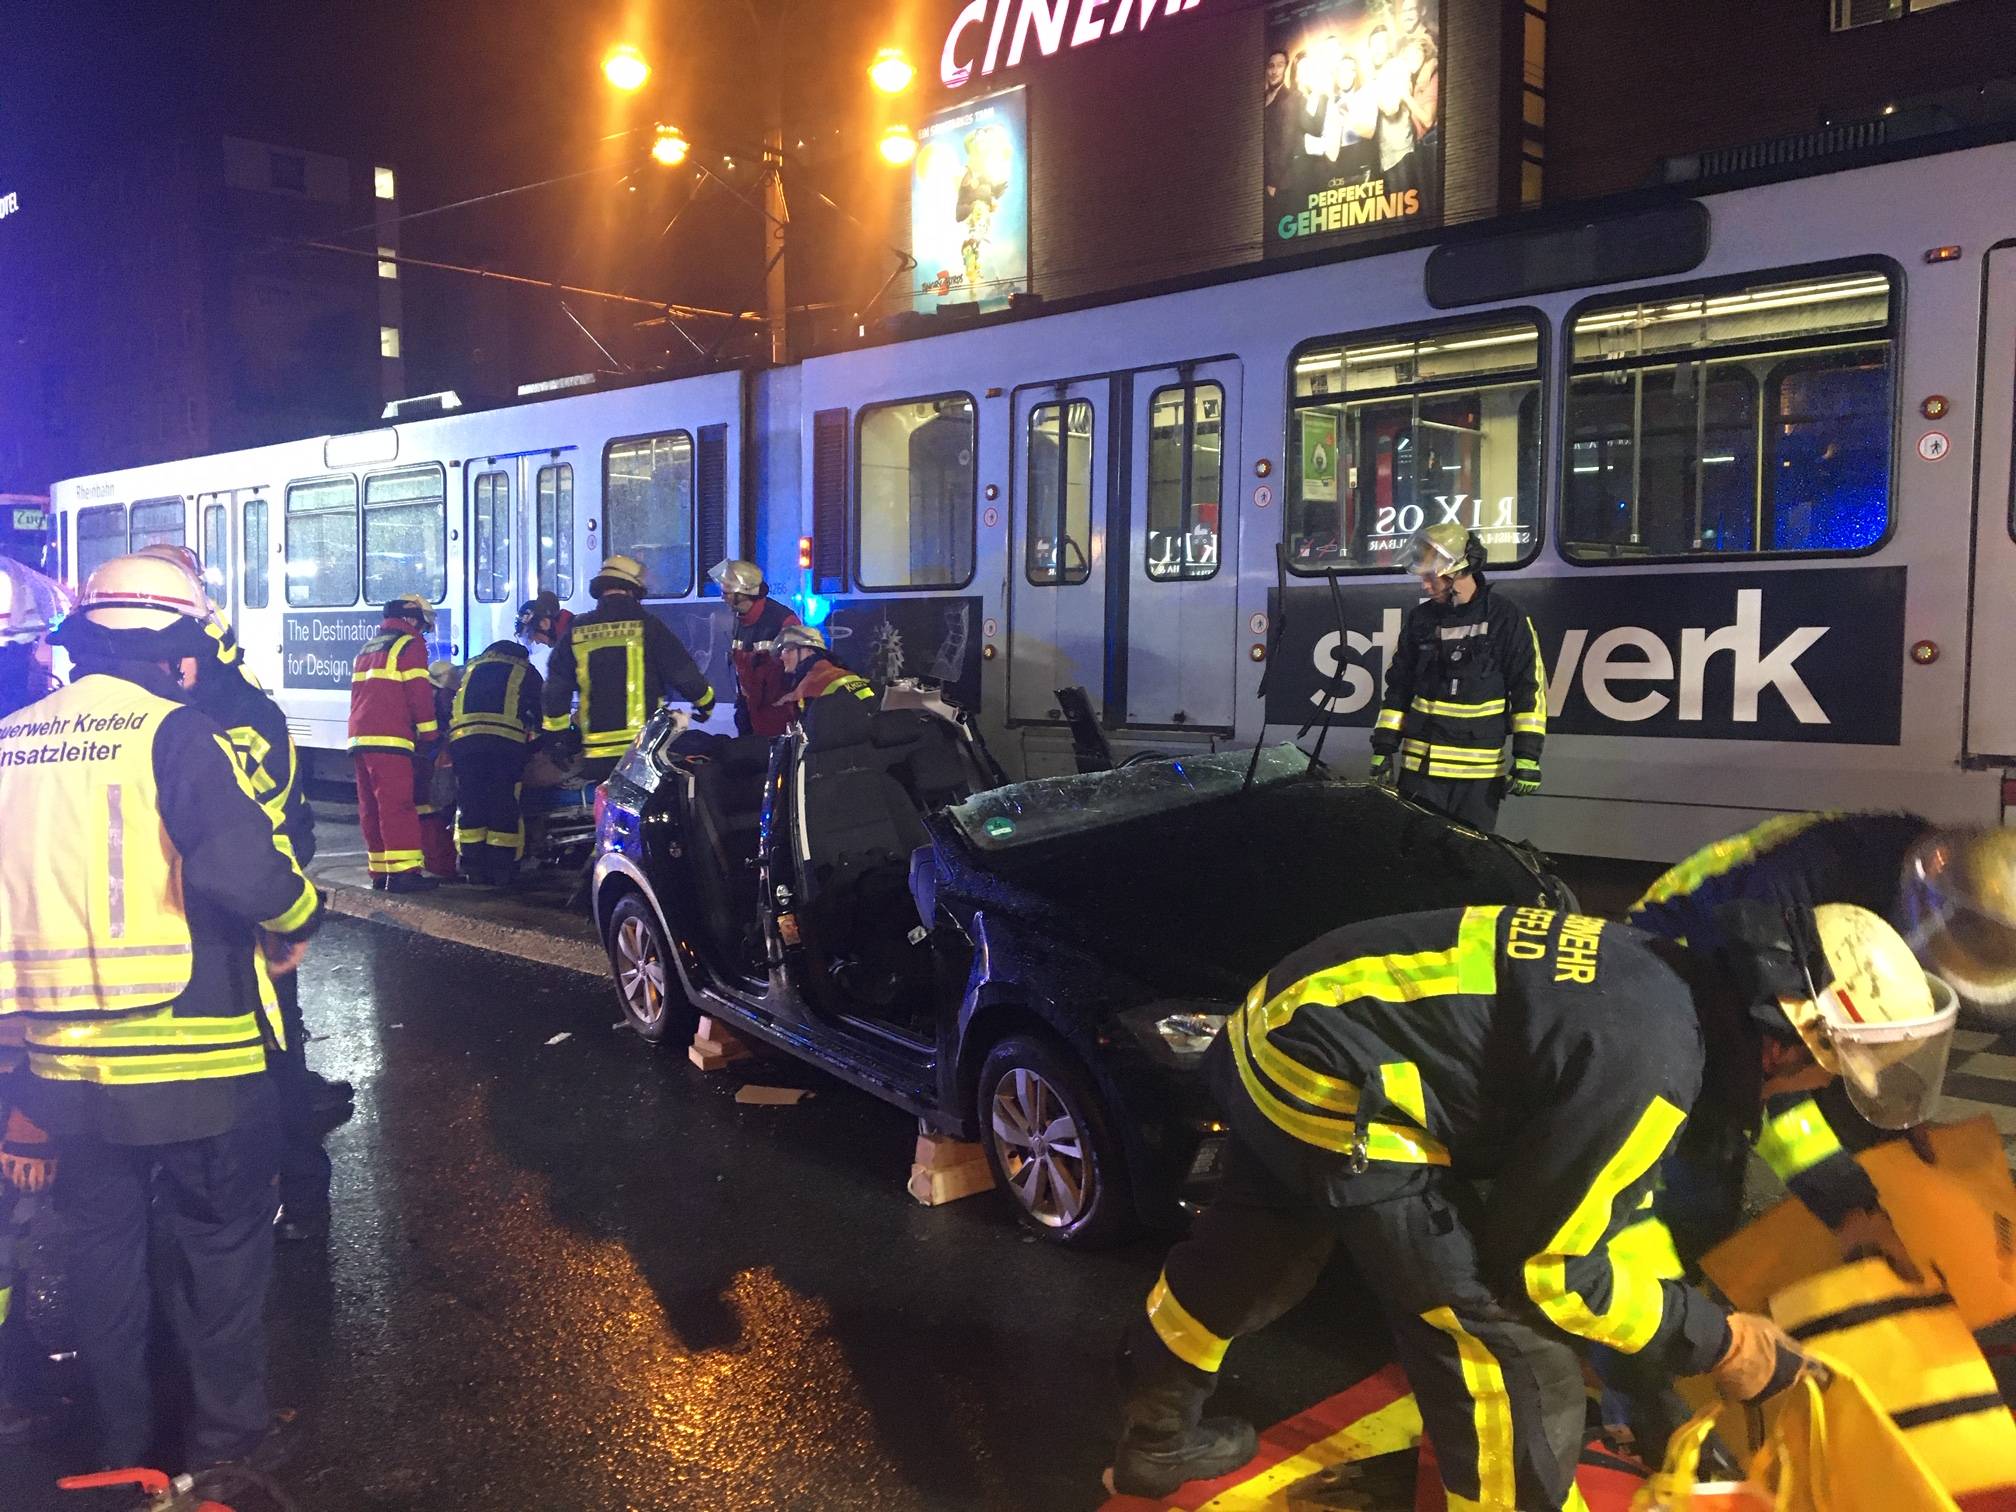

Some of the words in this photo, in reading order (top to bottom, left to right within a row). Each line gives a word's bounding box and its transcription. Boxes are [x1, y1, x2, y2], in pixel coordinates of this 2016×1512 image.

[941, 0, 1201, 88] CINE
[1308, 179, 1384, 209] PERFEKTE
[1328, 177, 1345, 187] das
[1278, 188, 1419, 240] GEHEIMNIS
[288, 619, 309, 641] The
[288, 653, 304, 675] for
[307, 653, 351, 683] Design.
[73, 712, 148, 734] Krefeld
[0, 740, 122, 767] nsatzleiter
